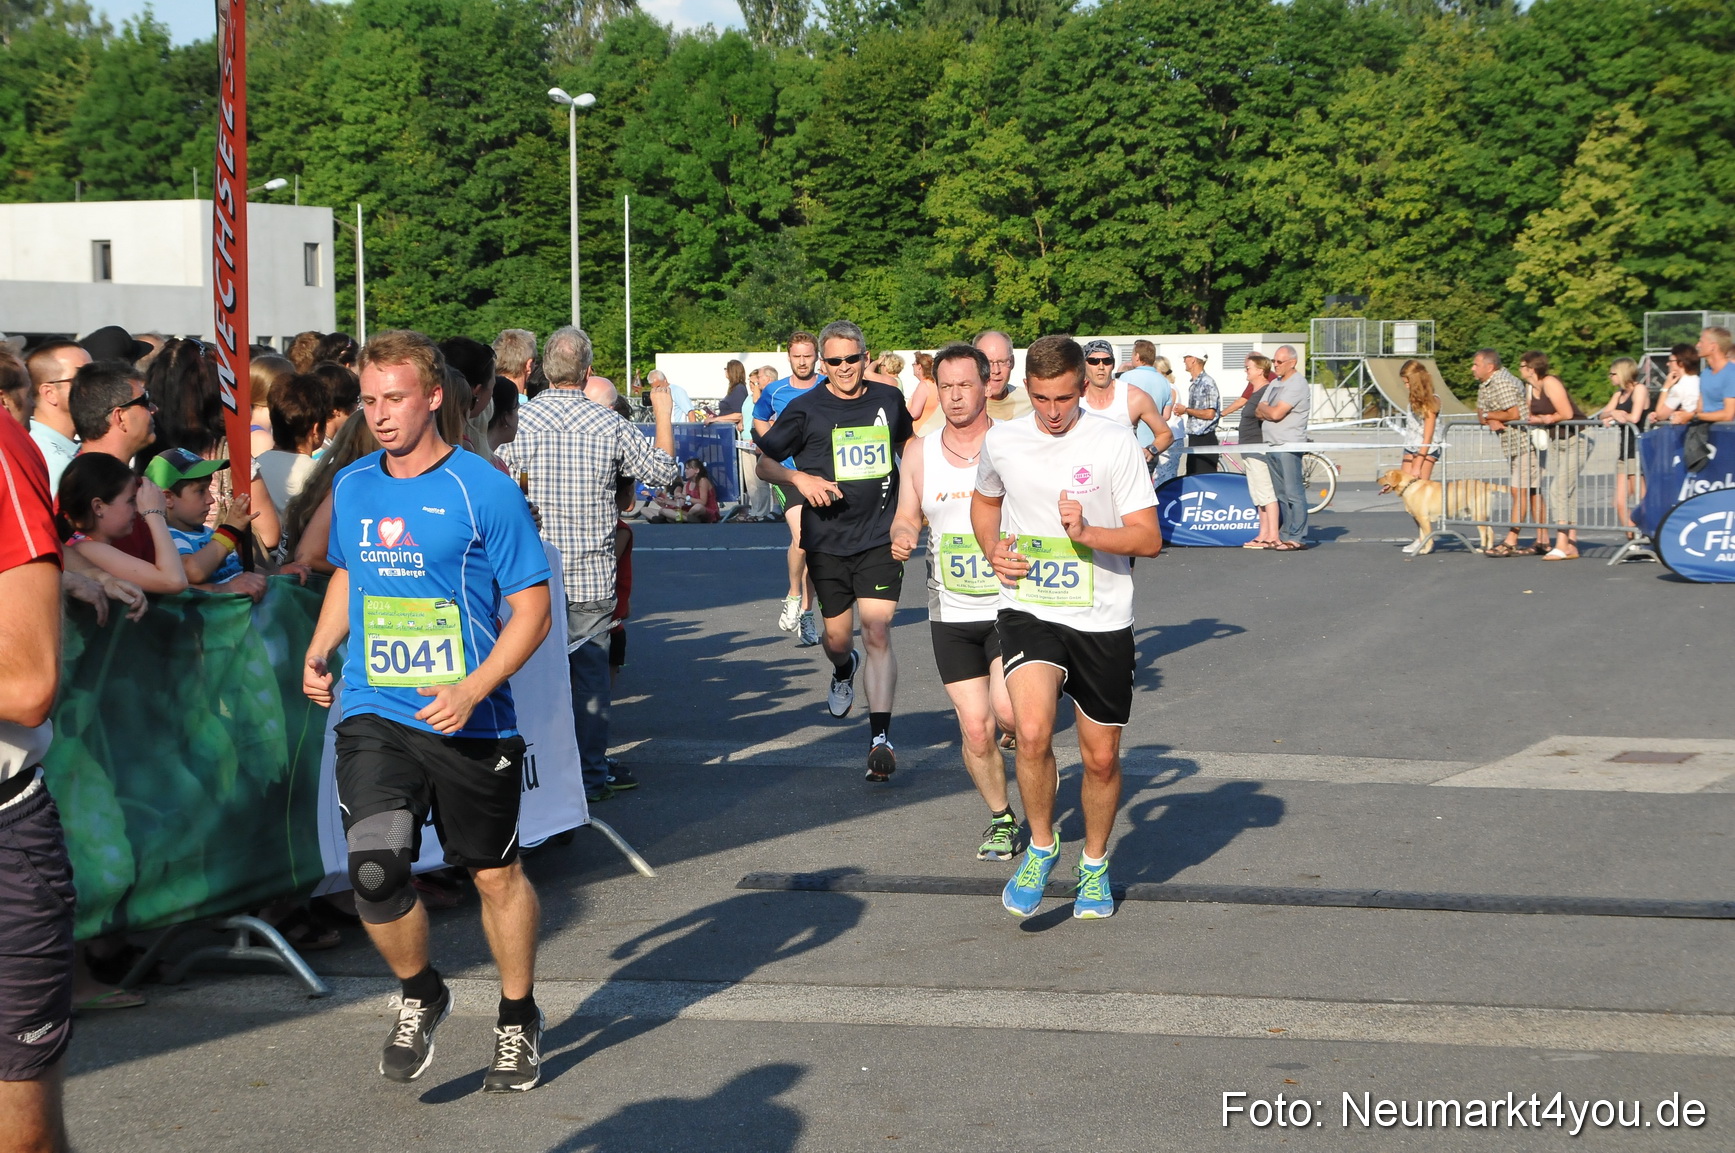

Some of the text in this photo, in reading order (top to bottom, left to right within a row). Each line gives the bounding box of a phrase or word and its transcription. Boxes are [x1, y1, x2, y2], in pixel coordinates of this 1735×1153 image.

[836, 444, 886, 467] 1051
[359, 518, 373, 547] I
[1189, 522, 1260, 531] AUTOMOBILE
[360, 547, 424, 568] camping
[950, 555, 996, 579] 513
[400, 568, 426, 579] Berger
[1026, 560, 1080, 588] 425
[367, 600, 391, 610] 2014
[370, 638, 454, 674] 5041
